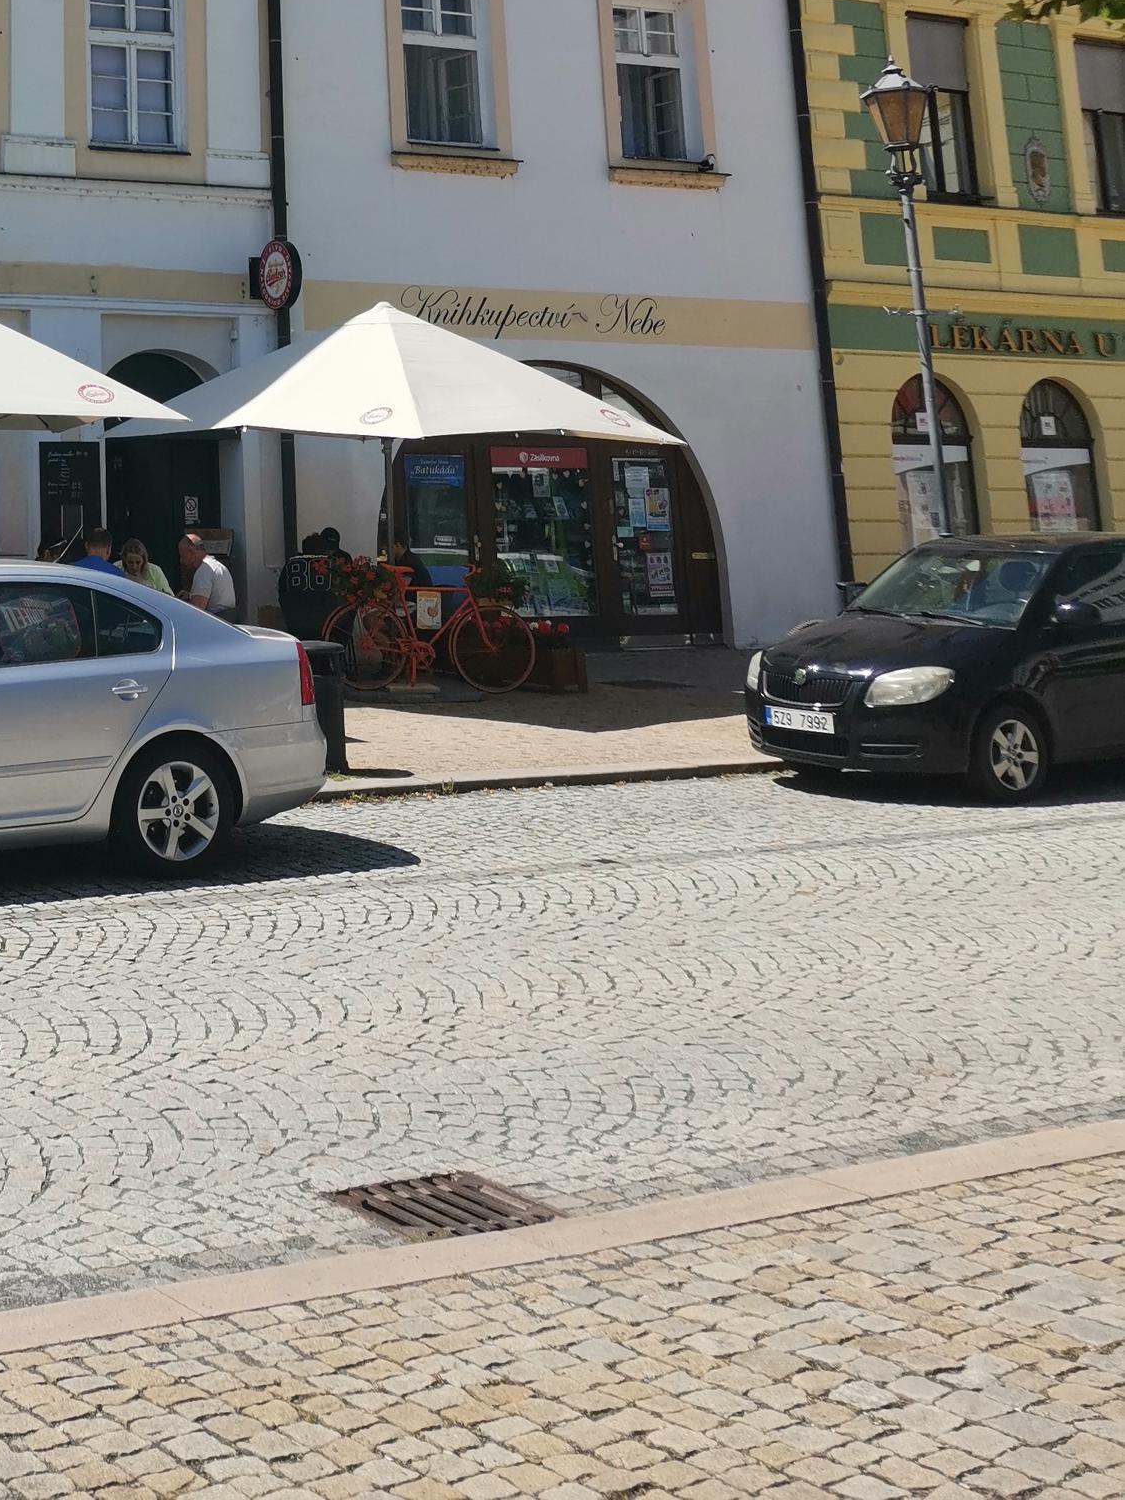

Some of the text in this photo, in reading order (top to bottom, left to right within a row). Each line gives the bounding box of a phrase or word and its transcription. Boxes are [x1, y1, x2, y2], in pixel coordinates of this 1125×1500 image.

[400, 284, 667, 340] Knihkupectví Nebe
[929, 316, 1116, 358] LÉKÁRNA U
[773, 709, 830, 731] 5Z9 7992
